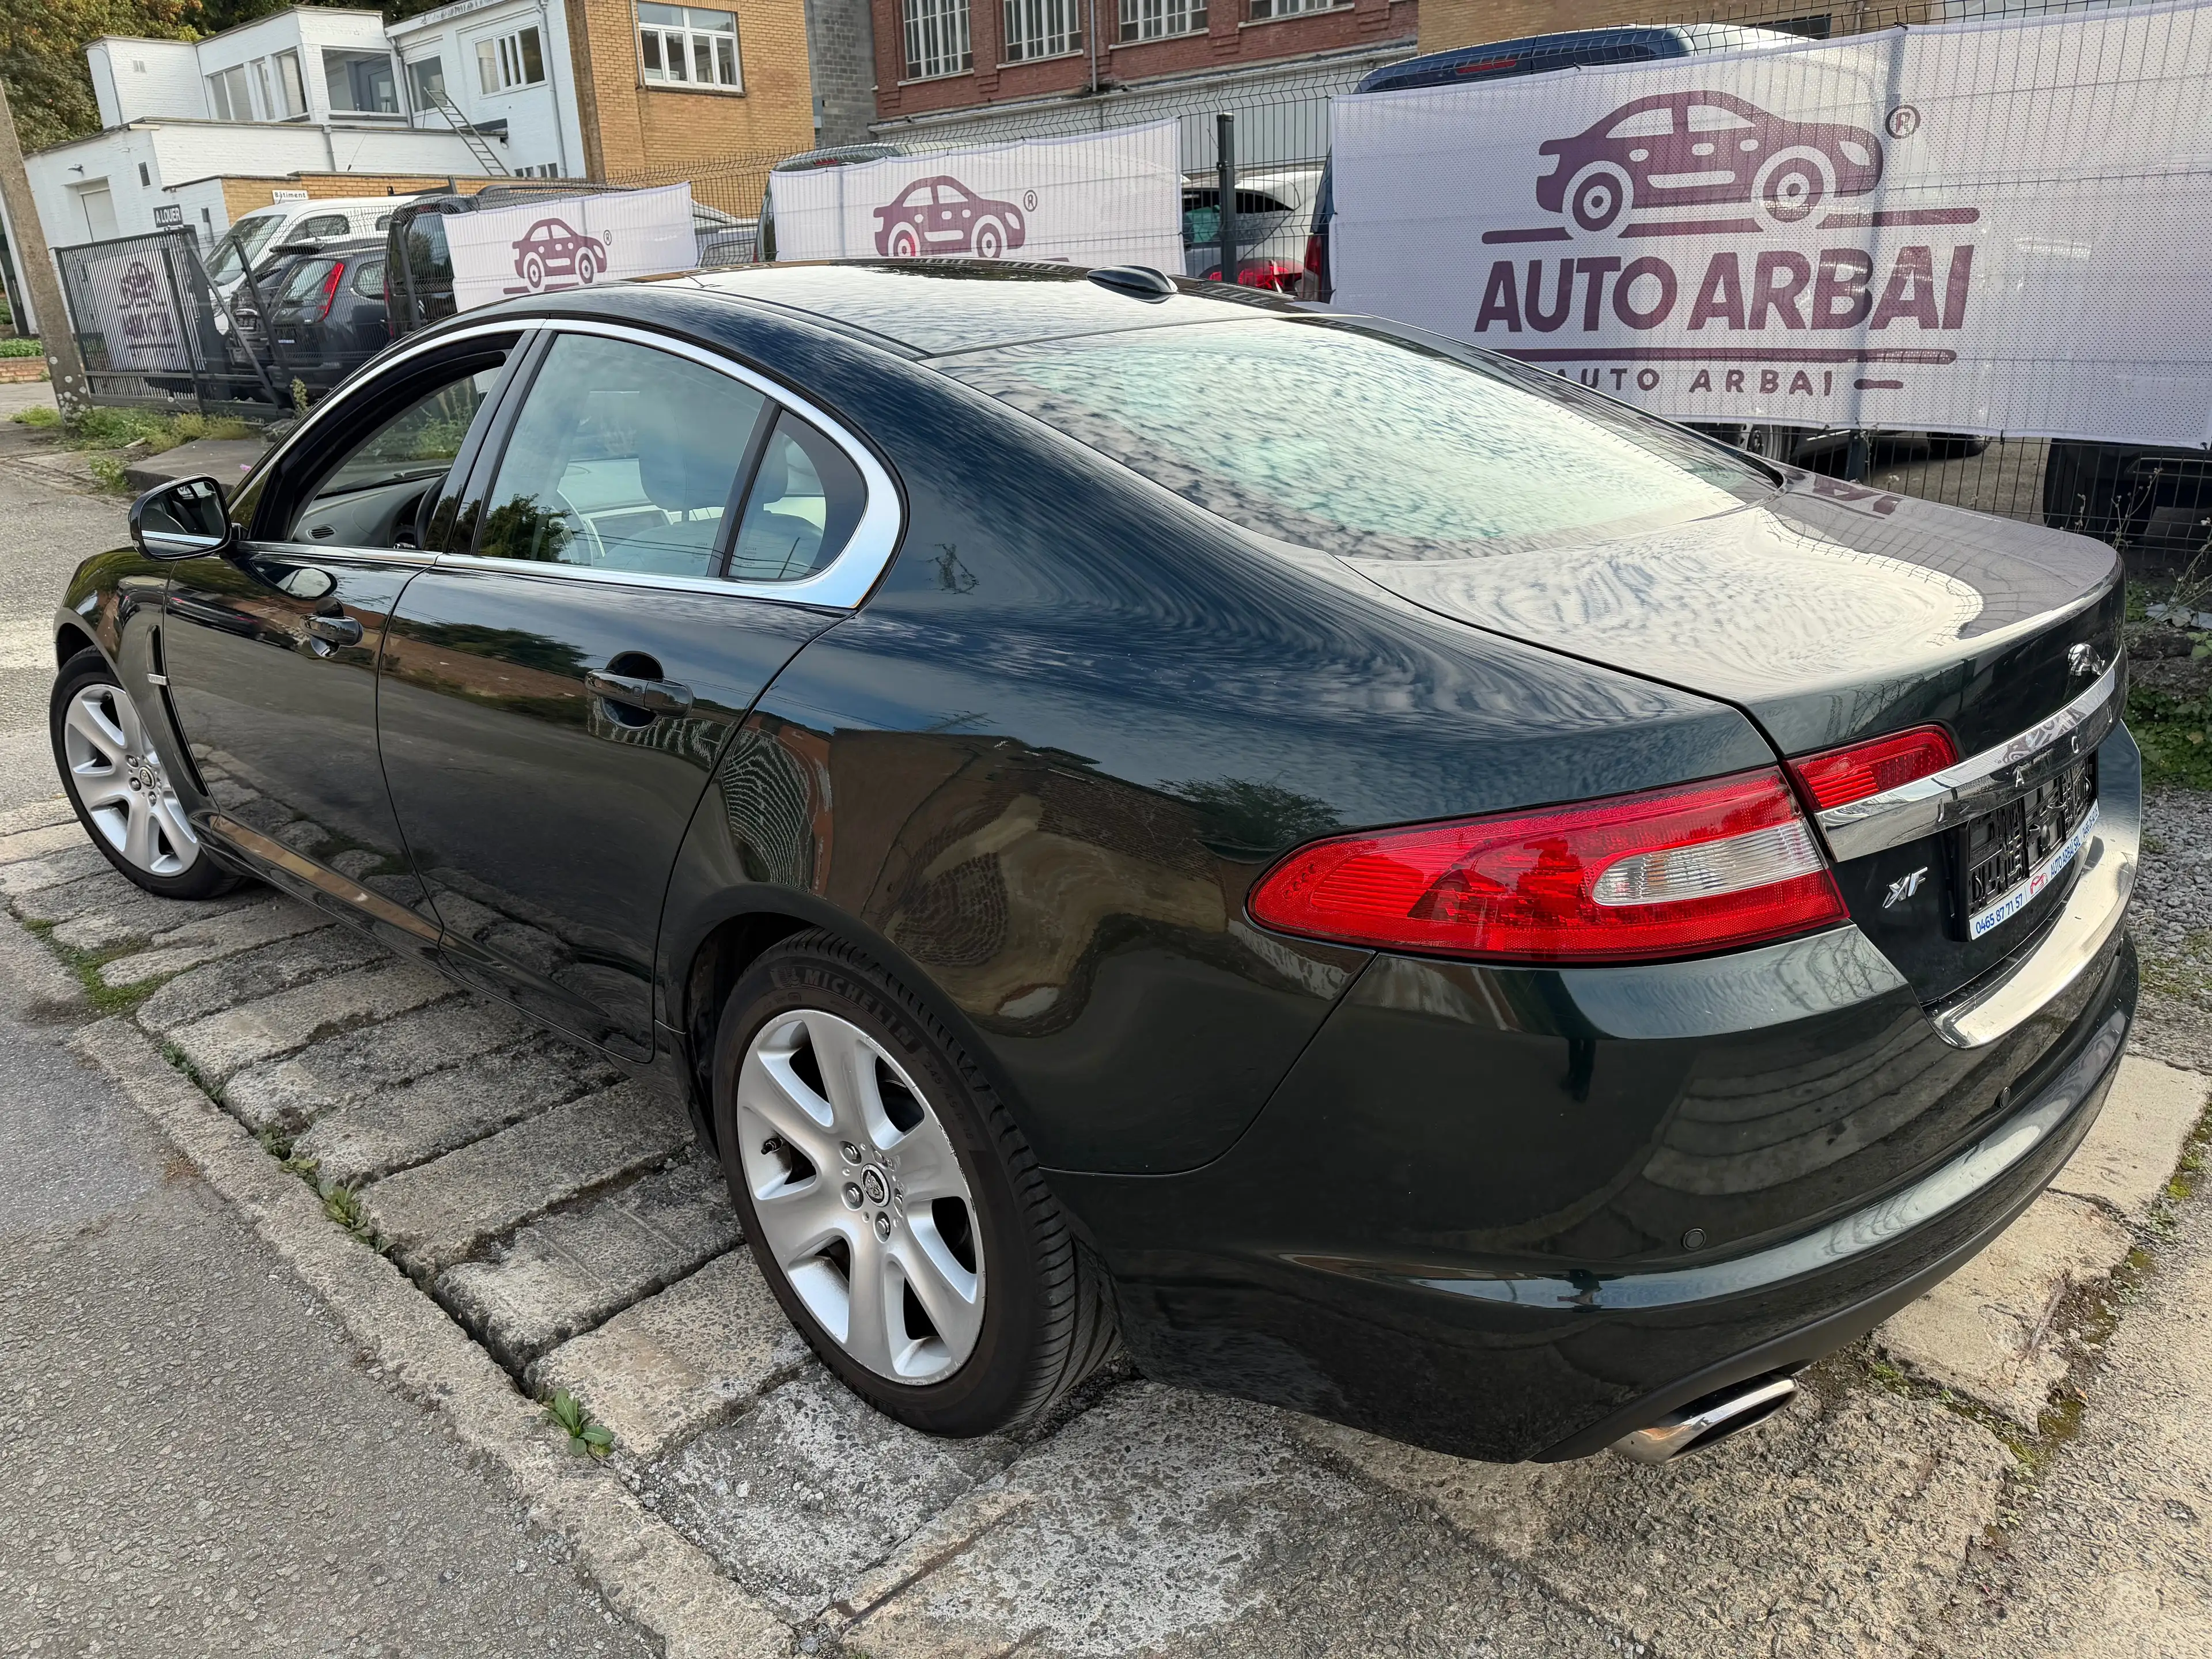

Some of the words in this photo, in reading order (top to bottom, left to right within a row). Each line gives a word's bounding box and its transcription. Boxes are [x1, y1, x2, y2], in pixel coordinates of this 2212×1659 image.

[156, 210, 161, 224] A
[160, 207, 181, 223] LOUER
[1474, 256, 1677, 332] AUTO
[1687, 244, 1974, 330] ARBAI
[1688, 369, 1832, 396] ARBAI
[1883, 866, 1928, 908] XF
[1976, 913, 1994, 934] 0465
[1996, 906, 2004, 922] 87
[2006, 900, 2013, 915] 71
[2015, 893, 2022, 908] 57
[2051, 856, 2062, 878] AUTO
[804, 968, 915, 1047] MICHELIN
